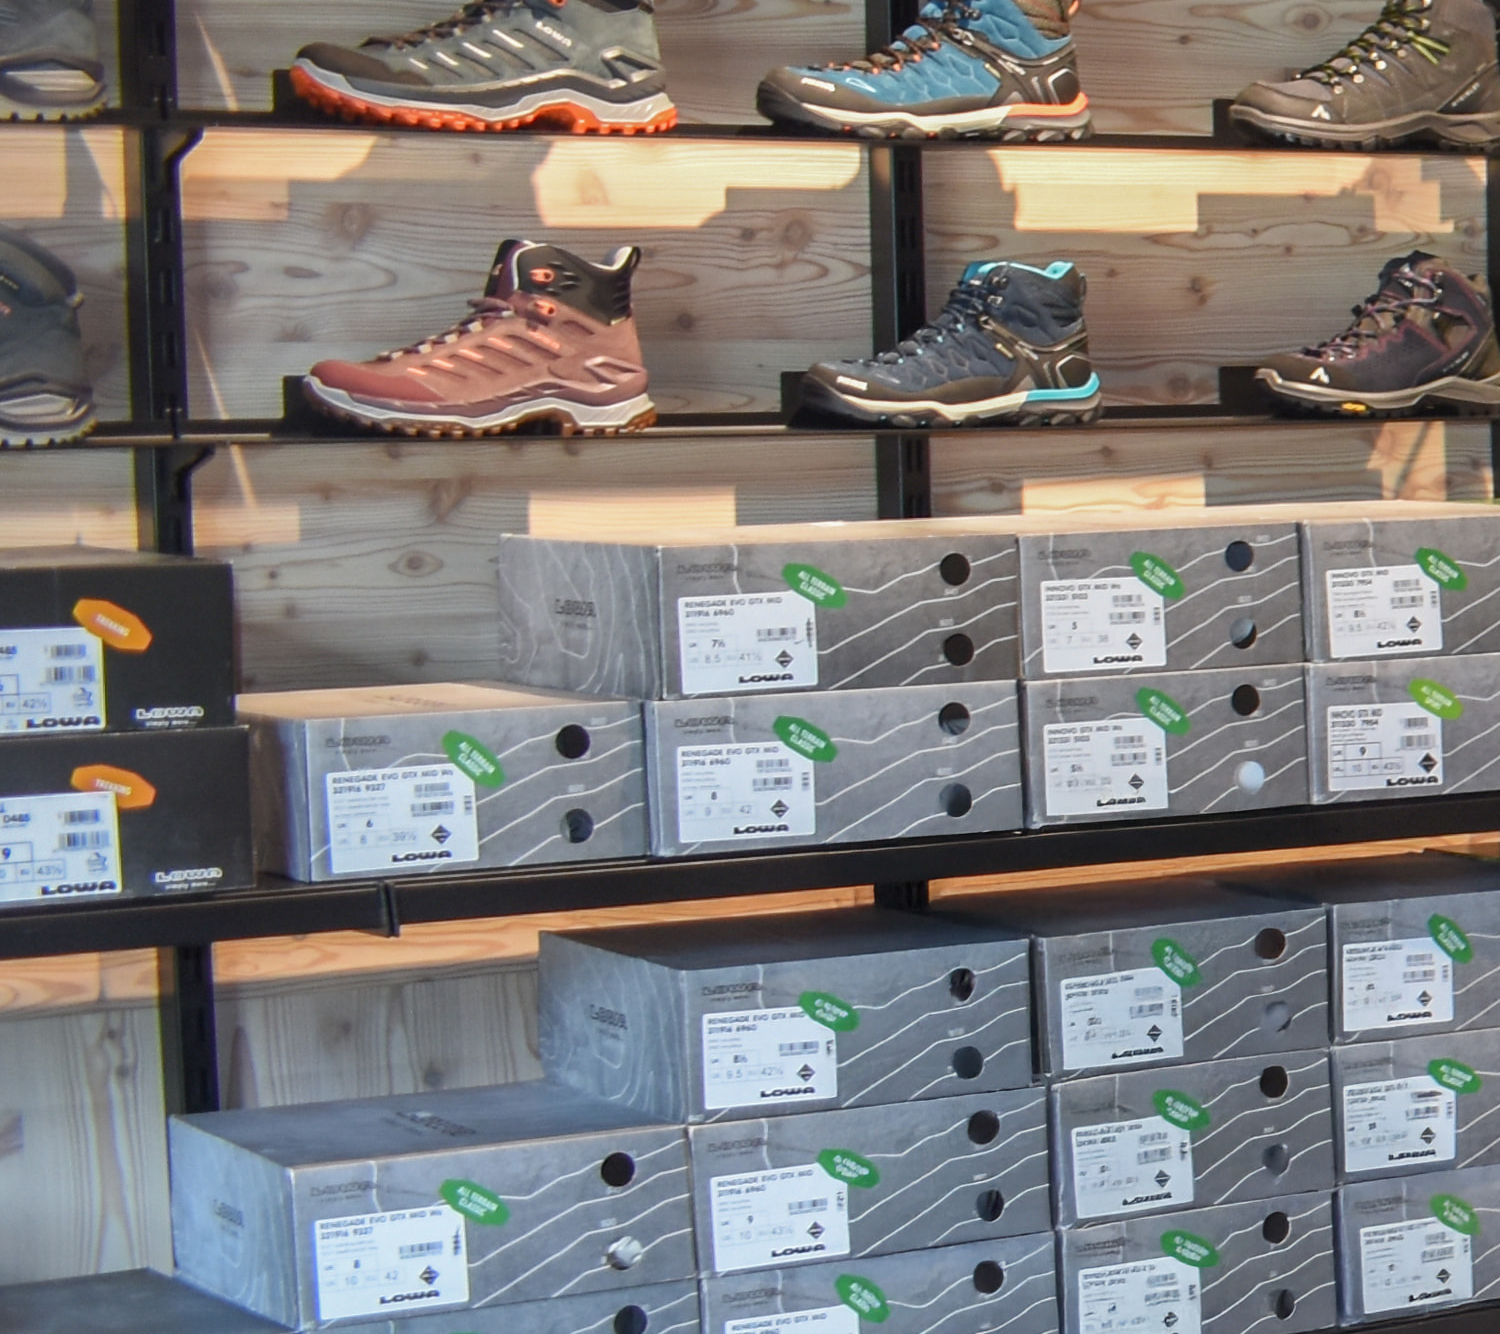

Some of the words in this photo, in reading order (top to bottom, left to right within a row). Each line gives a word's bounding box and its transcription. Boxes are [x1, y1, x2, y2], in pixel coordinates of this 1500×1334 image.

[685, 599, 727, 610] RENEGADE
[729, 598, 746, 607] EVO
[1377, 638, 1423, 649] LOWA
[1093, 654, 1143, 665] LOWA
[738, 672, 794, 684] LOWA
[135, 705, 204, 719] LOWA
[26, 715, 101, 729] LOWA
[680, 748, 724, 759] RENEGADE
[726, 747, 743, 756] EVO
[332, 773, 379, 785] RENEGADE
[381, 771, 399, 782] EVO
[1386, 775, 1439, 787] LOWA
[733, 823, 790, 835] LOWA
[391, 849, 452, 863] LOWA
[155, 866, 224, 883] LOWA
[41, 880, 117, 896] LOWA
[759, 1086, 816, 1098] LOWA
[320, 1218, 366, 1231] RENEGADE
[368, 1216, 388, 1227] EVO
[770, 1243, 826, 1258] LOWA
[379, 1289, 441, 1305] LOWA
